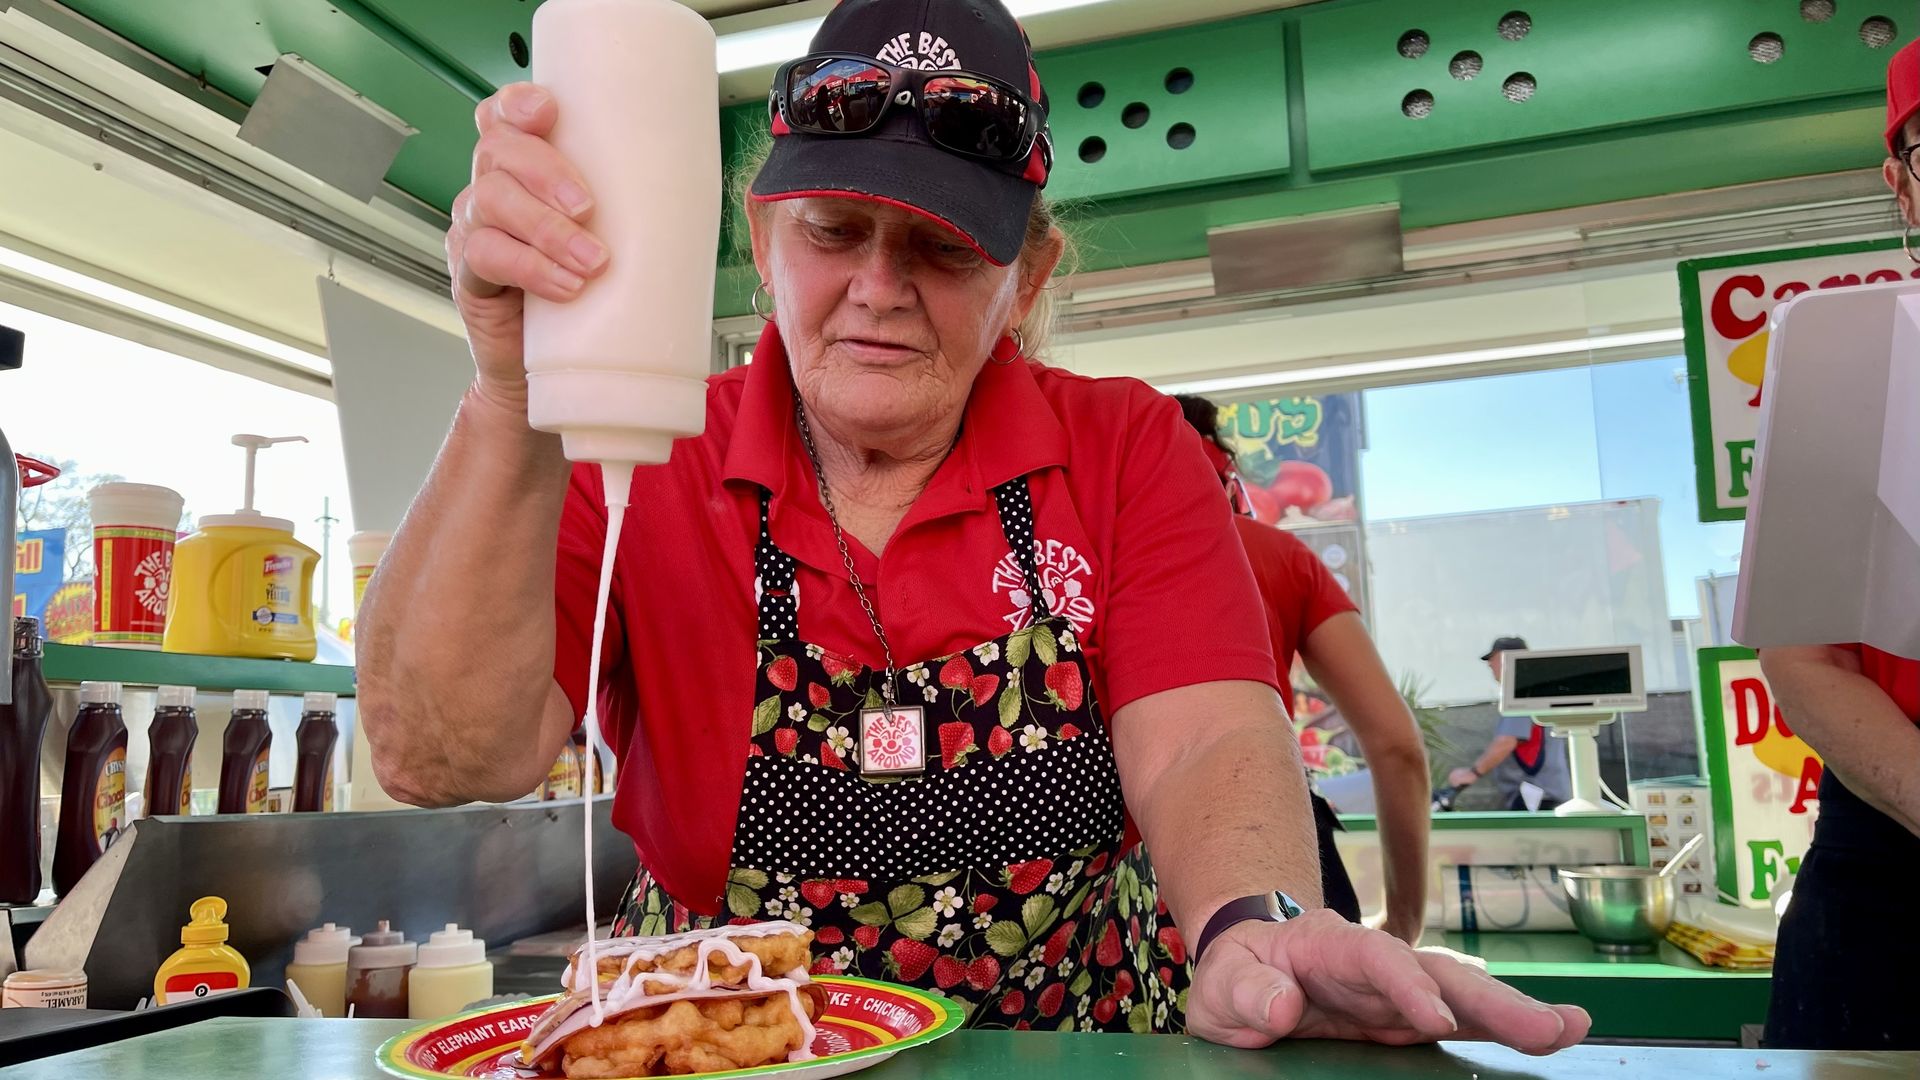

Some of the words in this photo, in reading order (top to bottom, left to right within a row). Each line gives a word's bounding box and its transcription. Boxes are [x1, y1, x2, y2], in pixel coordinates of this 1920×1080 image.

[876, 33, 913, 65] THE
[918, 32, 961, 70] BEST
[134, 551, 163, 576] THE
[992, 552, 1023, 593] THE
[1033, 539, 1092, 577] BEST
[865, 717, 887, 739] THE
[890, 714, 918, 736] BEST
[867, 746, 917, 768] AROUND
[46, 995, 85, 1008] CARAMEL
[437, 1025, 499, 1055] ELEPHANT
[498, 1015, 538, 1034] EARS
